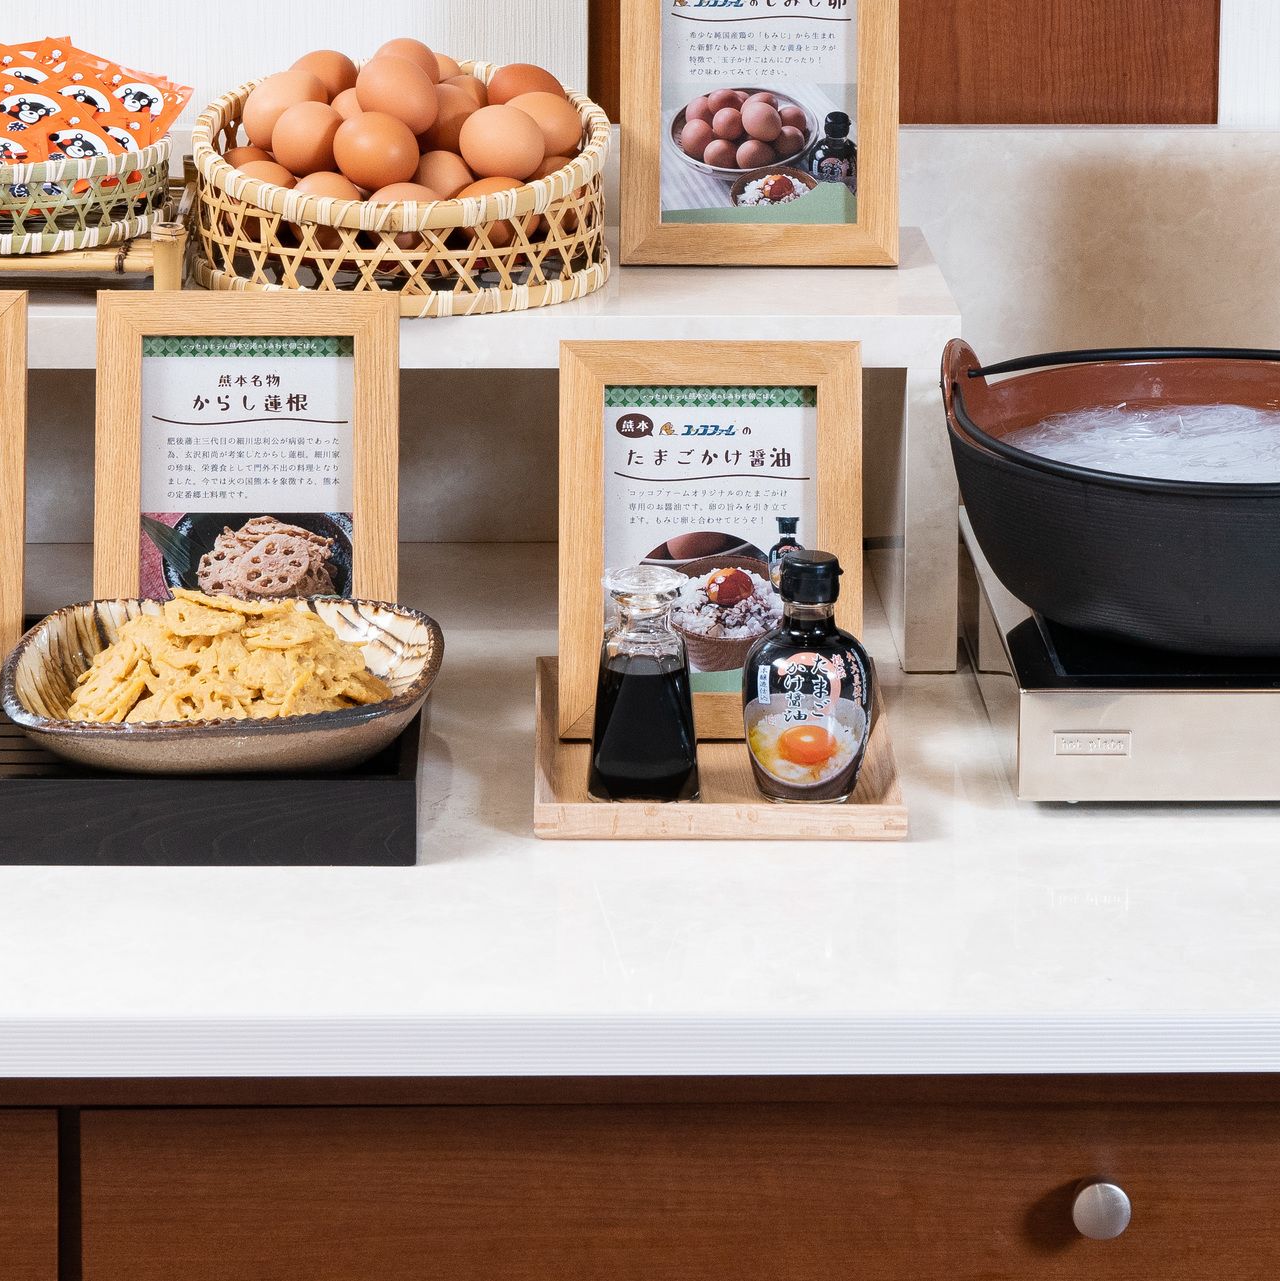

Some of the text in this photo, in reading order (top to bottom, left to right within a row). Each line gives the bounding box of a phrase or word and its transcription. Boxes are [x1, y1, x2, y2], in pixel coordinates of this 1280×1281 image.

[218, 374, 281, 388] 熊本名物
[193, 393, 309, 412] からし蓮根
[621, 420, 649, 433] 熊本
[167, 437, 339, 446] 肥後藩主三代目の細川忠利公が病弱であった
[627, 447, 791, 467] たまごかけ醤油
[167, 490, 250, 499] の定番郷土料理です。
[784, 662, 807, 722] かけ醤油
[811, 653, 830, 718] たまご
